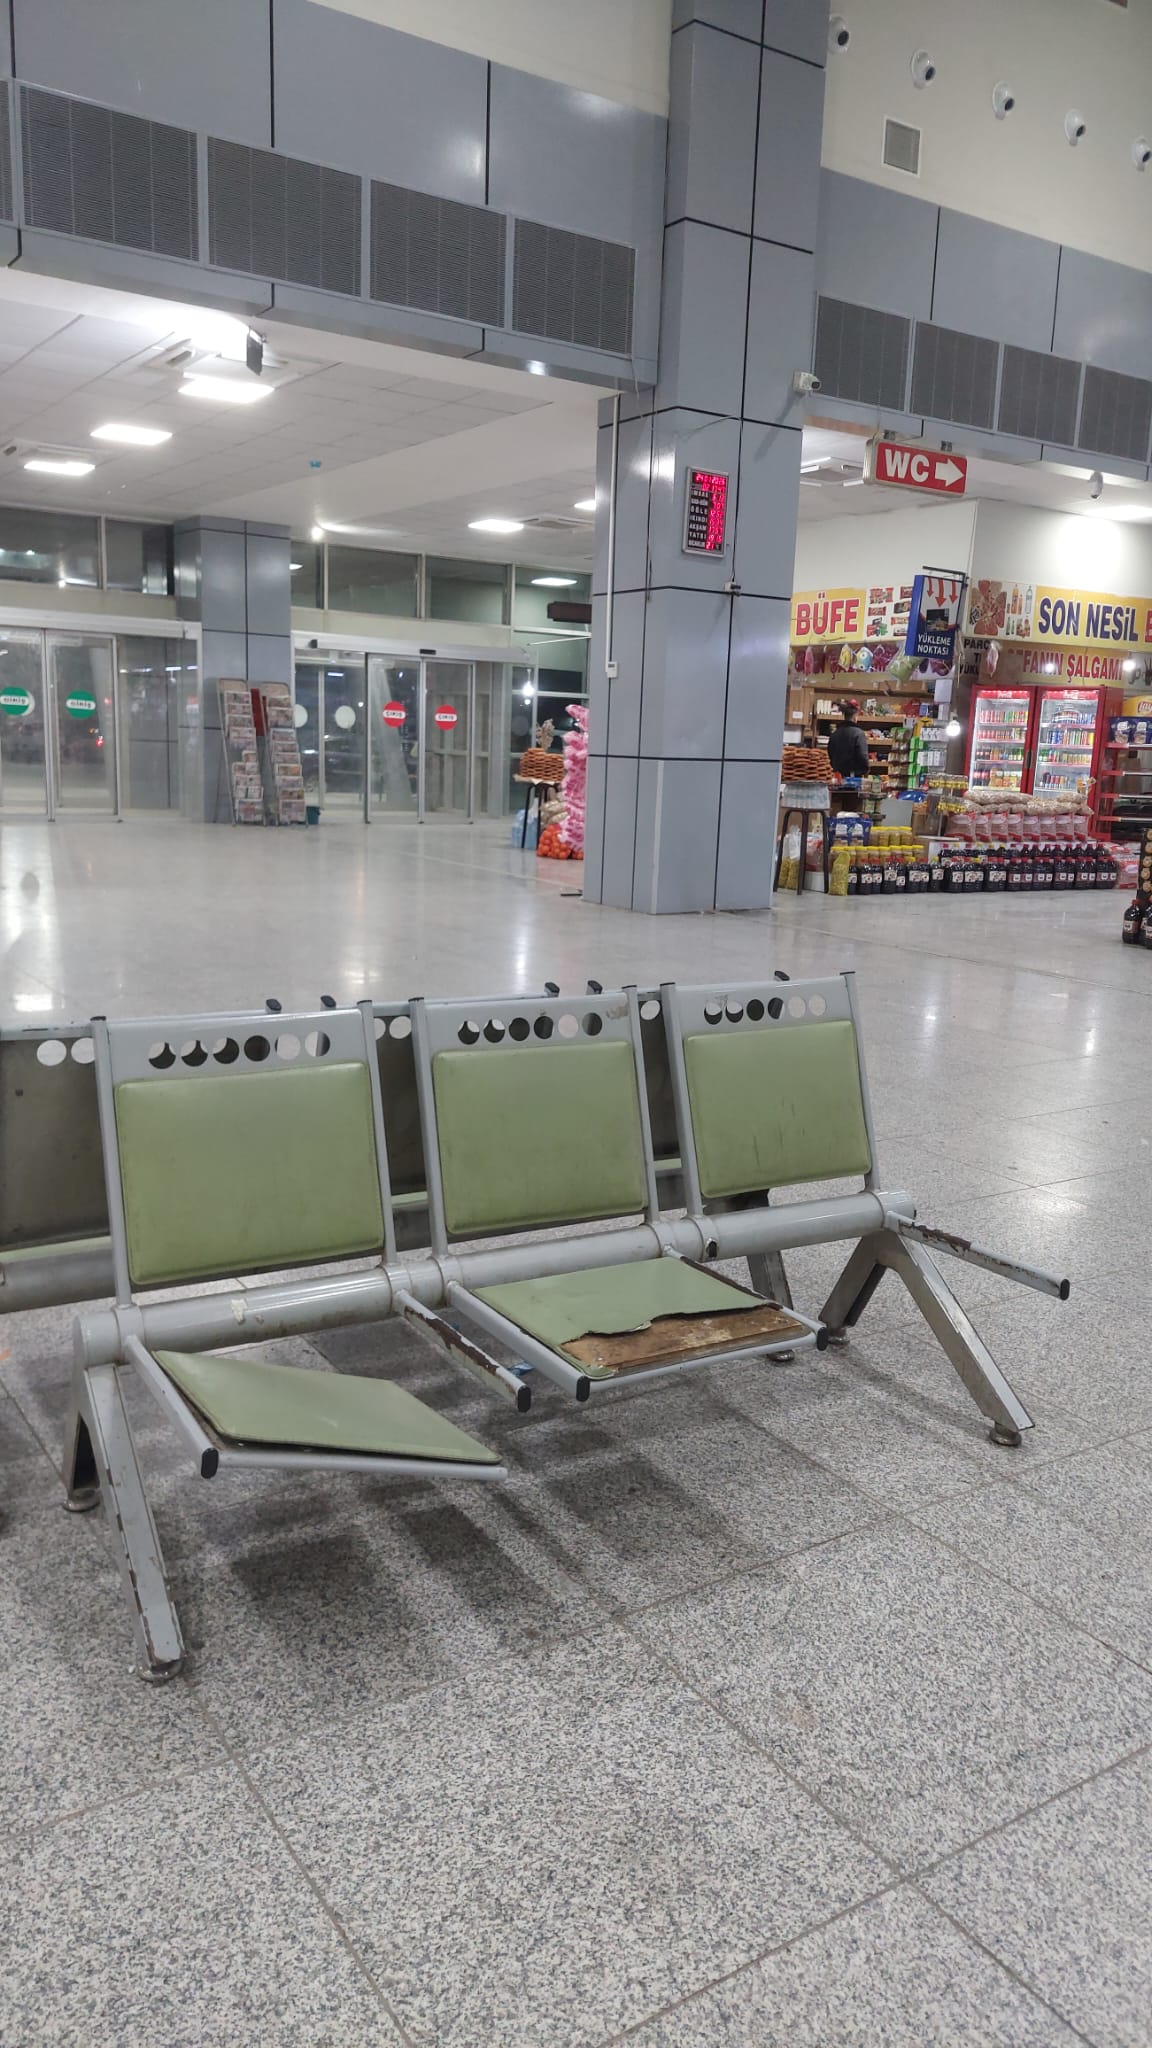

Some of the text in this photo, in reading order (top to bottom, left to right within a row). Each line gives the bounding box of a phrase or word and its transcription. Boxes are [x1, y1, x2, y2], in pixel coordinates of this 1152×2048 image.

[885, 449, 930, 483] WC
[795, 592, 860, 636] BÜFE
[1038, 597, 1081, 636] SON
[918, 631, 952, 646] YÜKLEME
